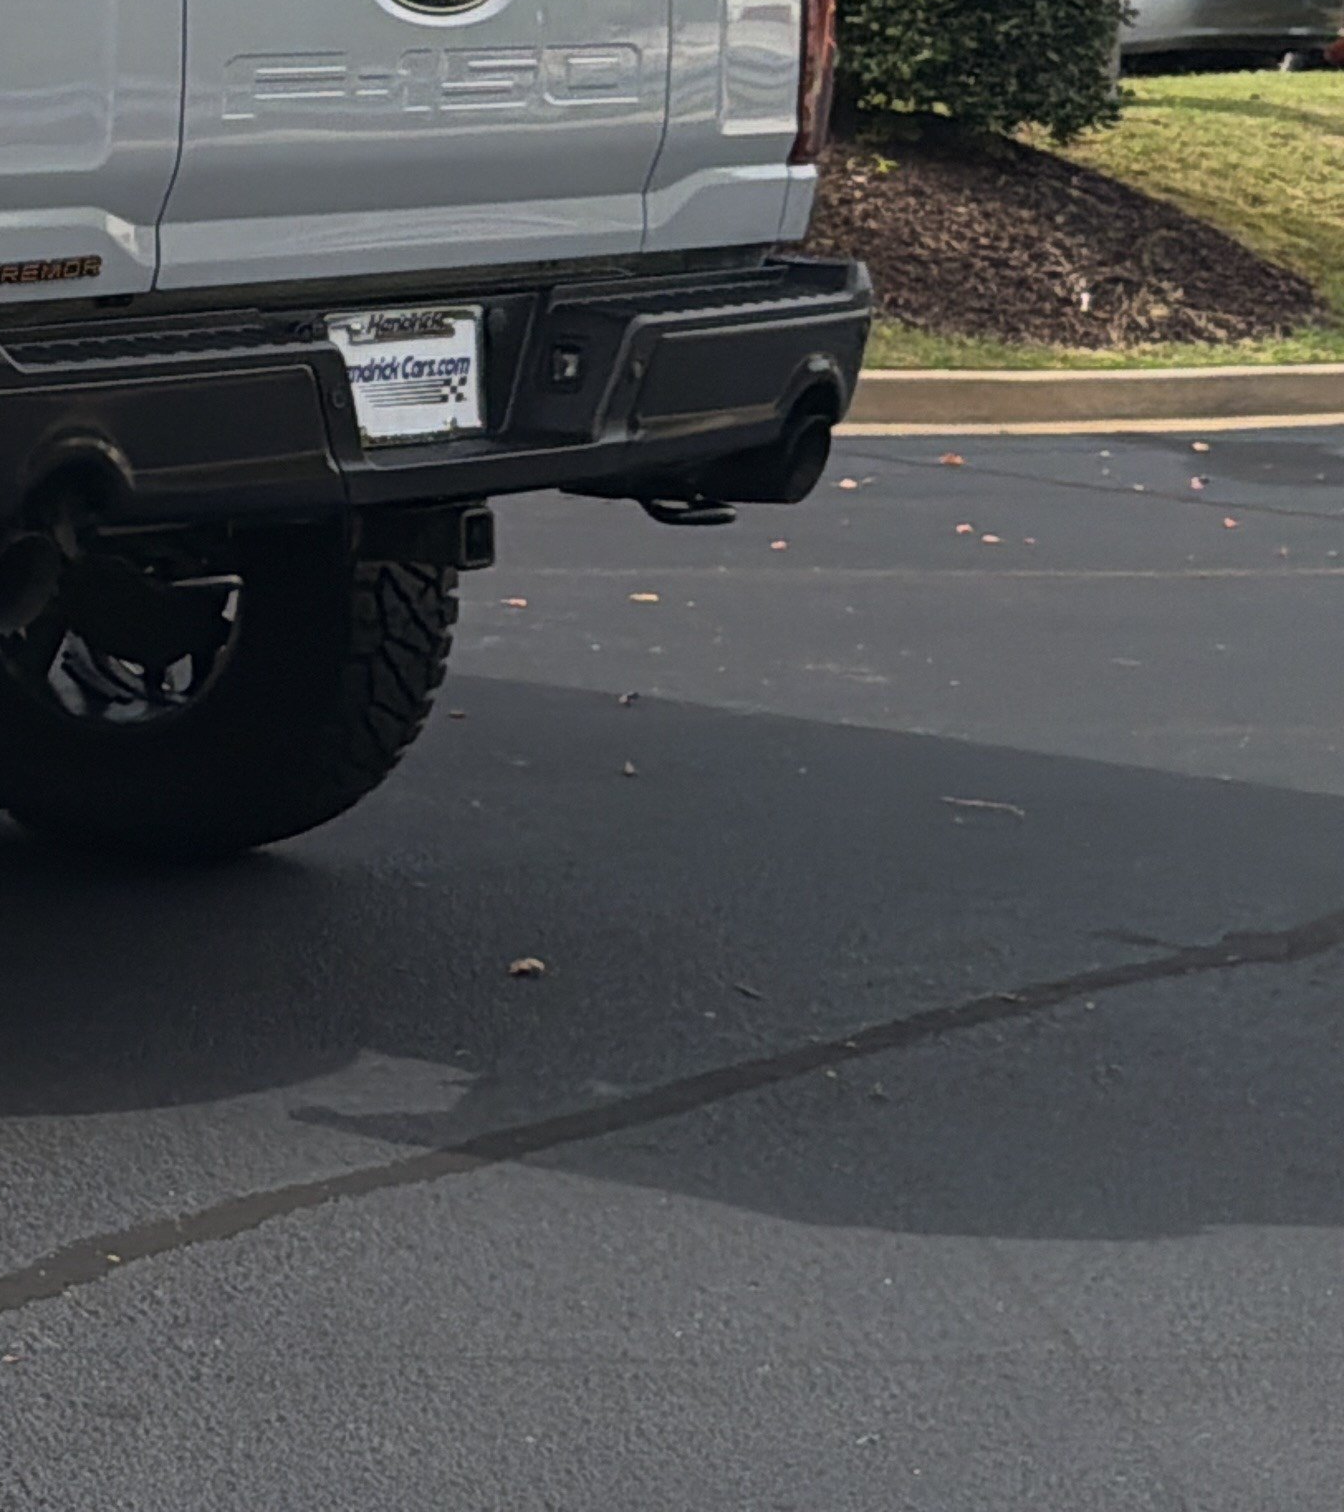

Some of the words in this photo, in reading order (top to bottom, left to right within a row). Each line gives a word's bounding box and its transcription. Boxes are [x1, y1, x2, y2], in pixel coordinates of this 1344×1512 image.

[221, 41, 641, 120] F-150
[346, 356, 401, 382] ndrick
[402, 355, 471, 379] Cars.com
